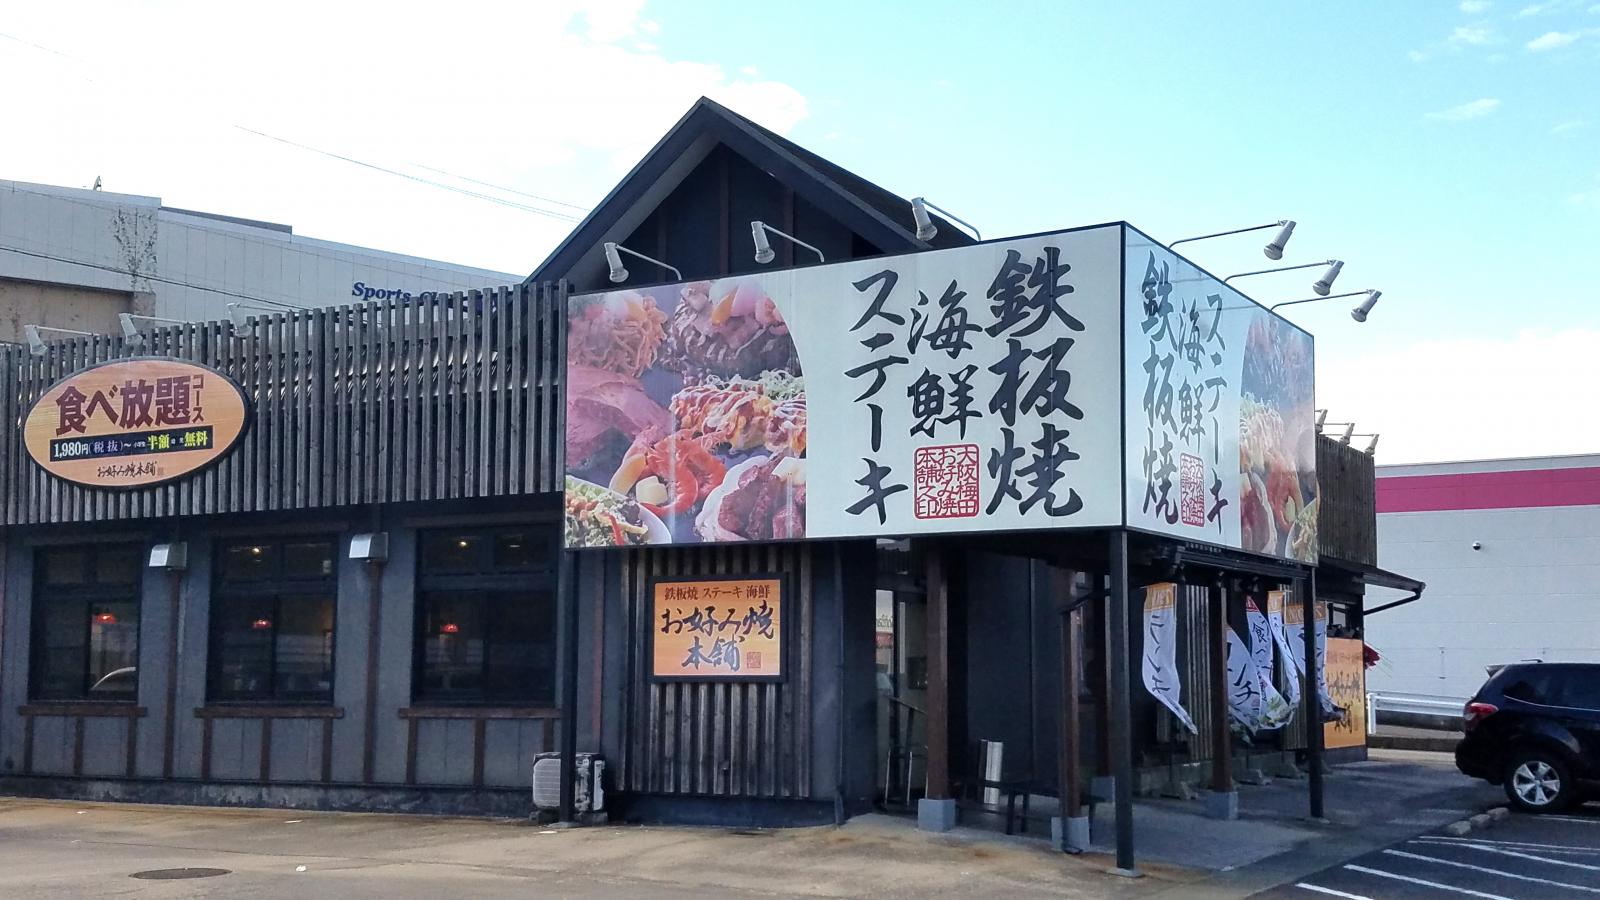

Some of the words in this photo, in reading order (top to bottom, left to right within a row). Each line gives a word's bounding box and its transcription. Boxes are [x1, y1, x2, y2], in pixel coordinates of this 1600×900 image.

[352, 282, 412, 302] Sports
[56, 375, 191, 437] 食べ放題
[192, 374, 204, 423] コース
[844, 269, 909, 525] ステーキ
[907, 279, 983, 440] 海鮮
[984, 246, 1086, 517] 鉄板焼
[1141, 250, 1178, 524] 鉄板焼
[1178, 297, 1206, 453] 海鮮
[1204, 293, 1229, 535] ステーキ
[184, 430, 208, 447] 無料
[661, 600, 774, 639] お好み焼
[664, 586, 699, 601] 鉄板焼
[703, 586, 743, 599] ステーキ
[746, 584, 771, 599] 海鮮
